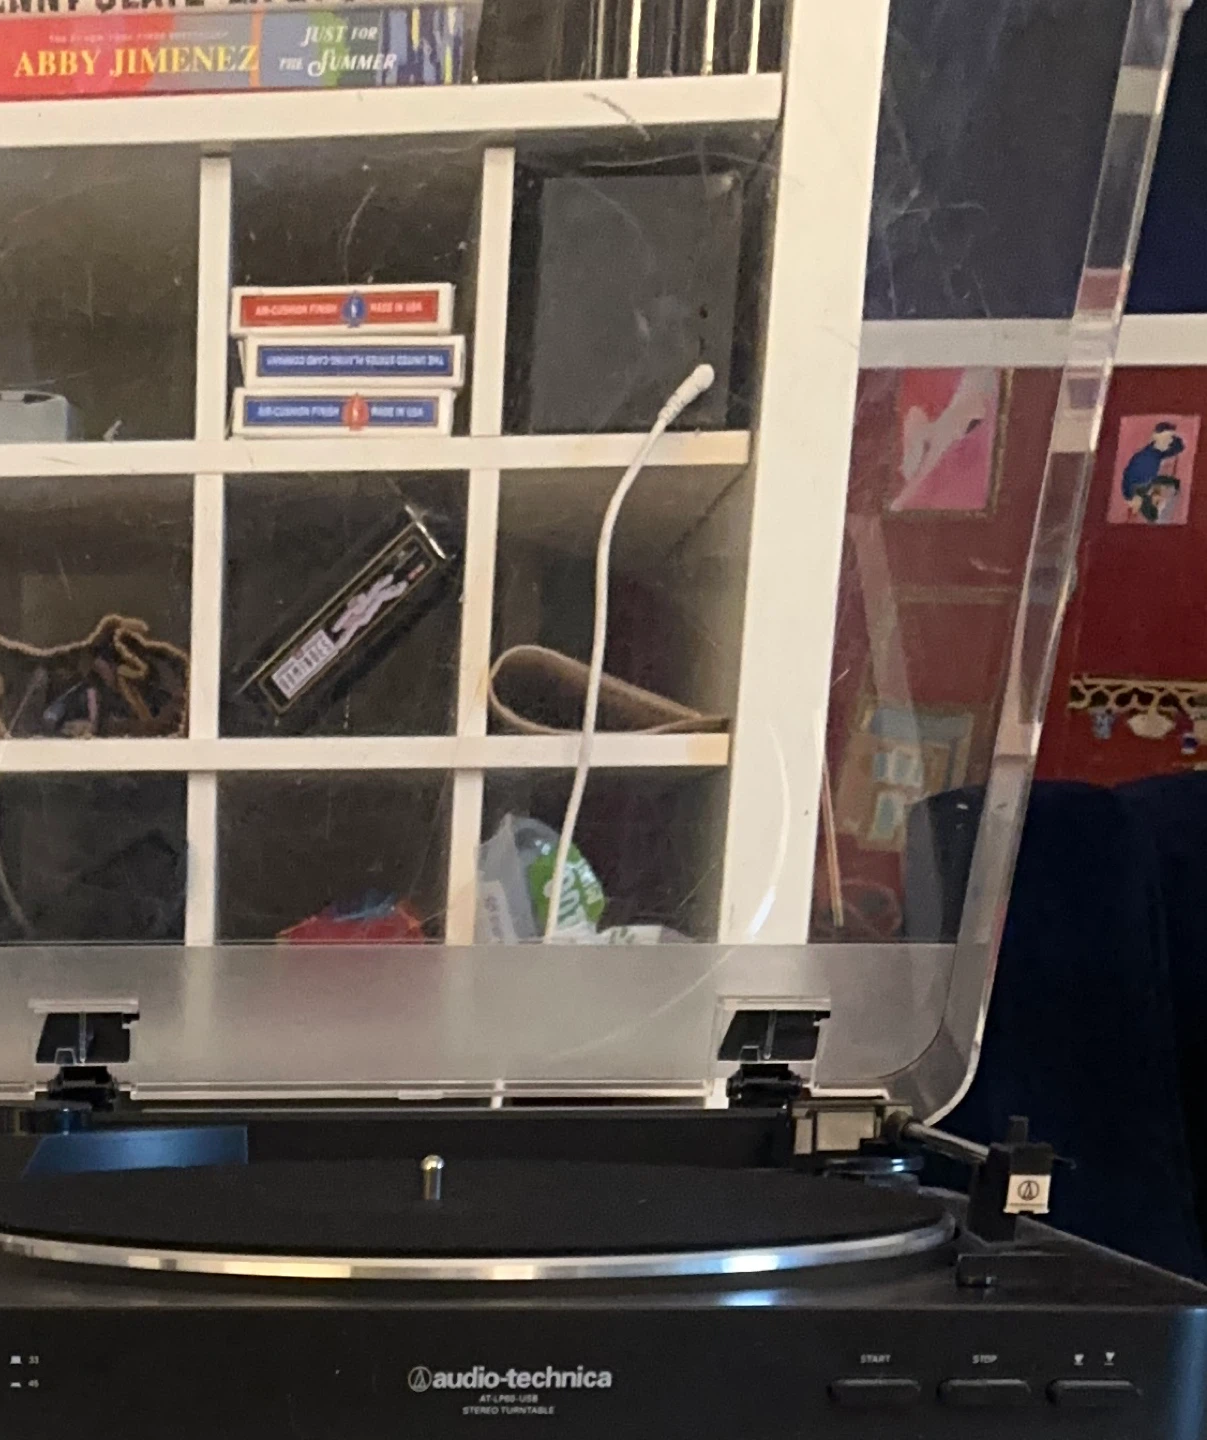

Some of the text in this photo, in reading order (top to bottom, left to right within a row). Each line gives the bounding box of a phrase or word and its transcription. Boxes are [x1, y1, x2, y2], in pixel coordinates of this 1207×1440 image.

[300, 25, 379, 48] JUST FOR
[14, 43, 259, 78] ABBY JIMENEZ
[279, 49, 397, 77] THE SUMMER
[860, 1354, 891, 1364] START
[972, 1355, 998, 1364] STOP
[432, 1365, 612, 1389] audio-technica
[462, 1406, 555, 1415] STEREO TURNTABLE
